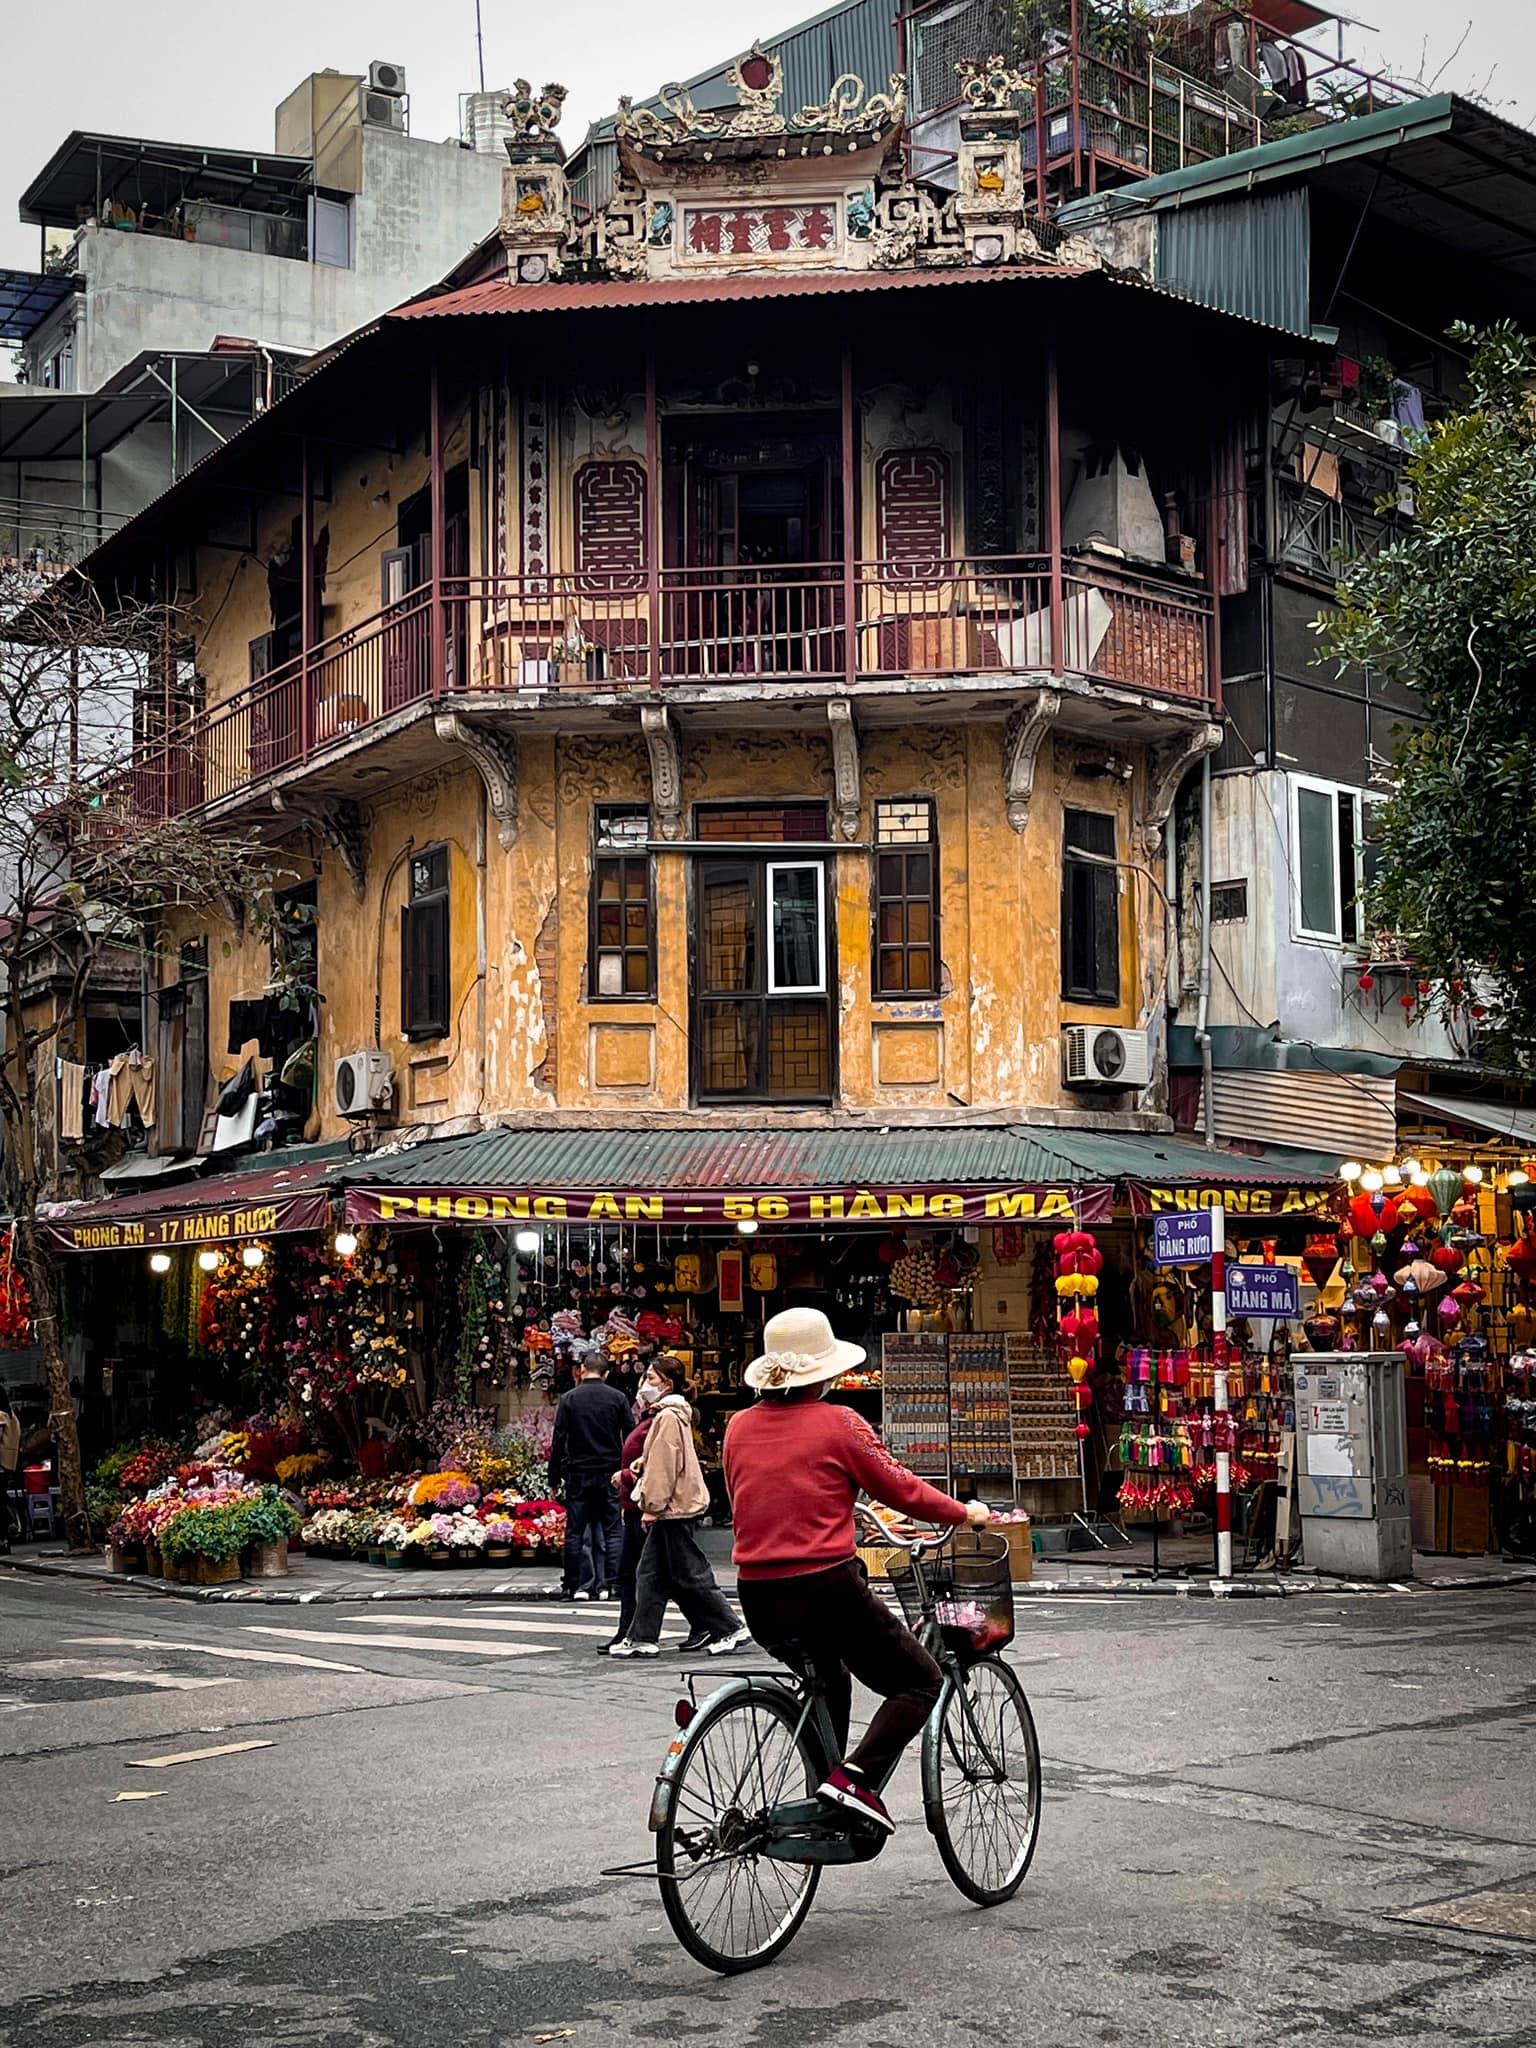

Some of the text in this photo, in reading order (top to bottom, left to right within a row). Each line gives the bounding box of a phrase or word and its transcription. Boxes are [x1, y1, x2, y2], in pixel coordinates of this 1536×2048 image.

[379, 1196, 568, 1220] PHONG
[587, 1192, 664, 1220] ÂN
[722, 1196, 790, 1219] 56
[809, 1190, 965, 1219] HÀNG
[985, 1189, 1077, 1218] MÃ
[1151, 1189, 1273, 1213] PHONG
[74, 1225, 120, 1249] PHONG
[160, 1220, 180, 1242] 17
[184, 1213, 229, 1241] HÀNG
[1178, 1216, 1198, 1231] PHỐ
[1159, 1234, 1210, 1258] HÀNG RƯƠI
[1254, 1271, 1278, 1284] PHỐ
[1231, 1286, 1293, 1310] HÀNG MÃ
